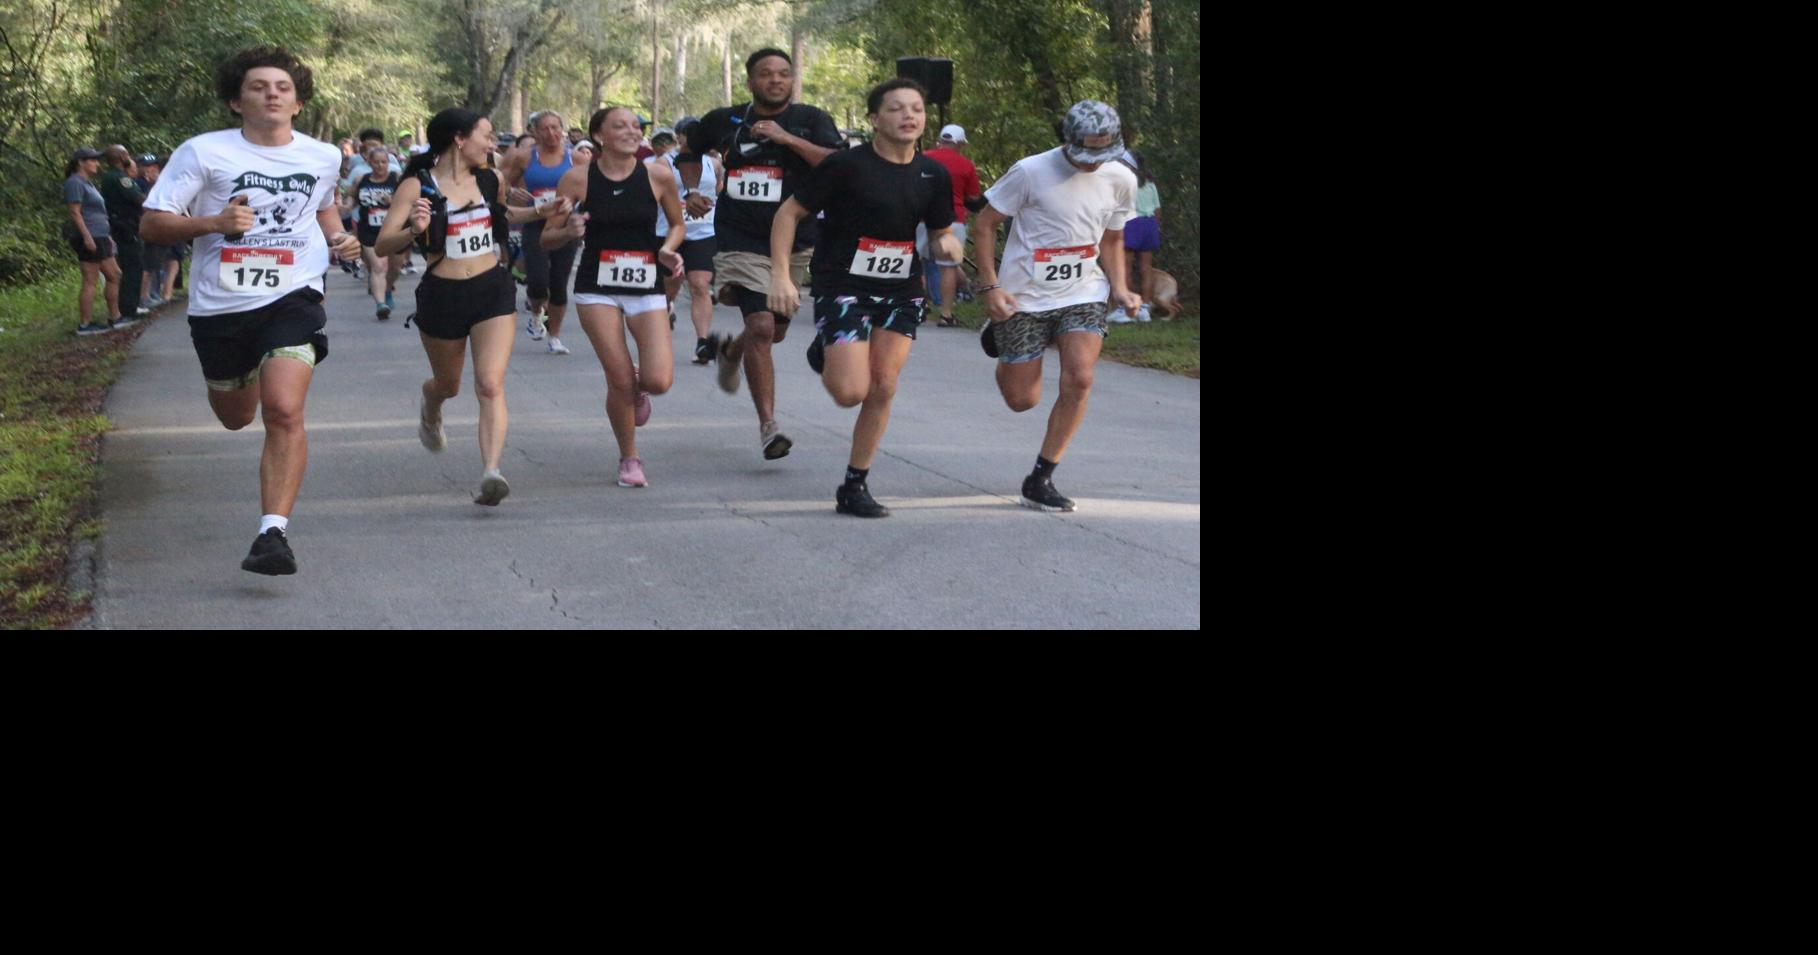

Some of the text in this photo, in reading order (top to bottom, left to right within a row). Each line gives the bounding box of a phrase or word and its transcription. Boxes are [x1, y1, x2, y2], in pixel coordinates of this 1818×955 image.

[244, 174, 283, 189] Fitness
[737, 181, 769, 197] 181
[457, 233, 491, 254] 184
[866, 256, 904, 274] 182
[1045, 262, 1083, 281] 291
[233, 268, 280, 288] 175
[610, 267, 647, 284] 183
